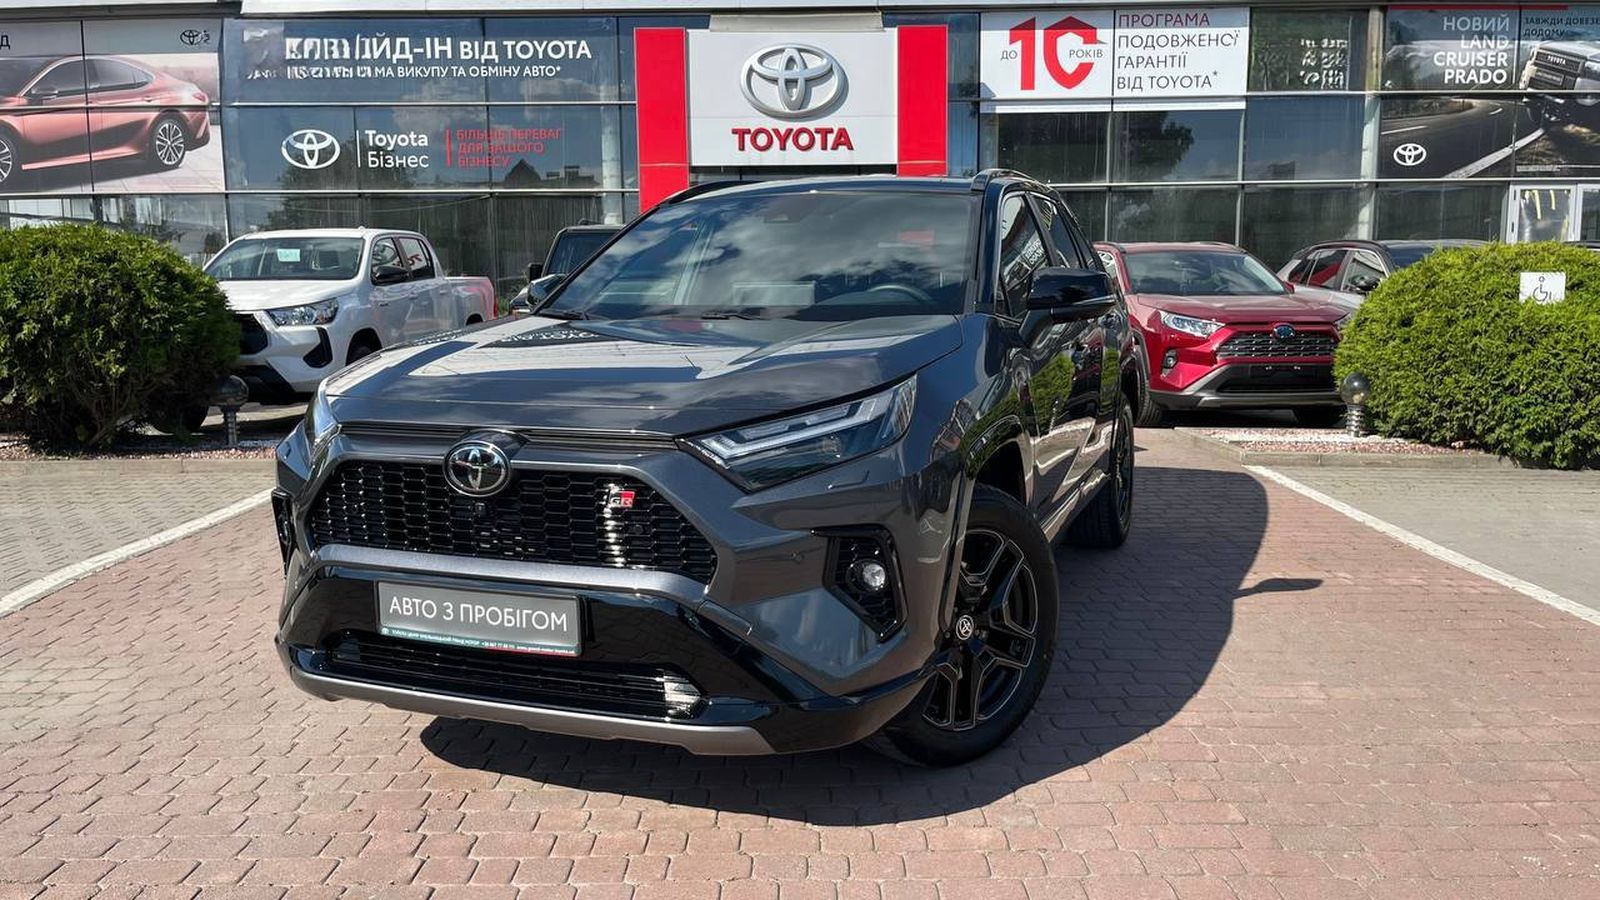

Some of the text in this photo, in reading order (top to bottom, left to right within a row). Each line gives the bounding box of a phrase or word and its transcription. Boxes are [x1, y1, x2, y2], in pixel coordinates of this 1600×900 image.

[1118, 13, 1210, 28] ПРОГРАМА
[1443, 14, 1510, 31] НОВИЙ
[1460, 35, 1510, 49] LAND
[459, 41, 499, 63] ВІД
[503, 40, 592, 59] TOYOTA
[1001, 49, 1018, 60] ДО
[1069, 48, 1104, 59] РОКІВ
[1433, 51, 1508, 67] CRUISER
[1117, 51, 1189, 69] ГАРАНТІЇ
[397, 65, 448, 78] ВИКУПУ
[451, 65, 466, 77] ТА
[469, 65, 520, 77] ОБМІНУ
[1444, 69, 1507, 84] PRADO
[1117, 76, 1143, 91] ВІД
[365, 129, 429, 151] Toyota
[457, 128, 560, 140] БІЛЬШЕ ПЕРЕВАГ
[731, 127, 854, 152] TOYOTA
[457, 142, 483, 155] ДЛЯ
[367, 151, 429, 168] Бізнес
[389, 596, 568, 632] АВТО З ПРОБІГОМ
